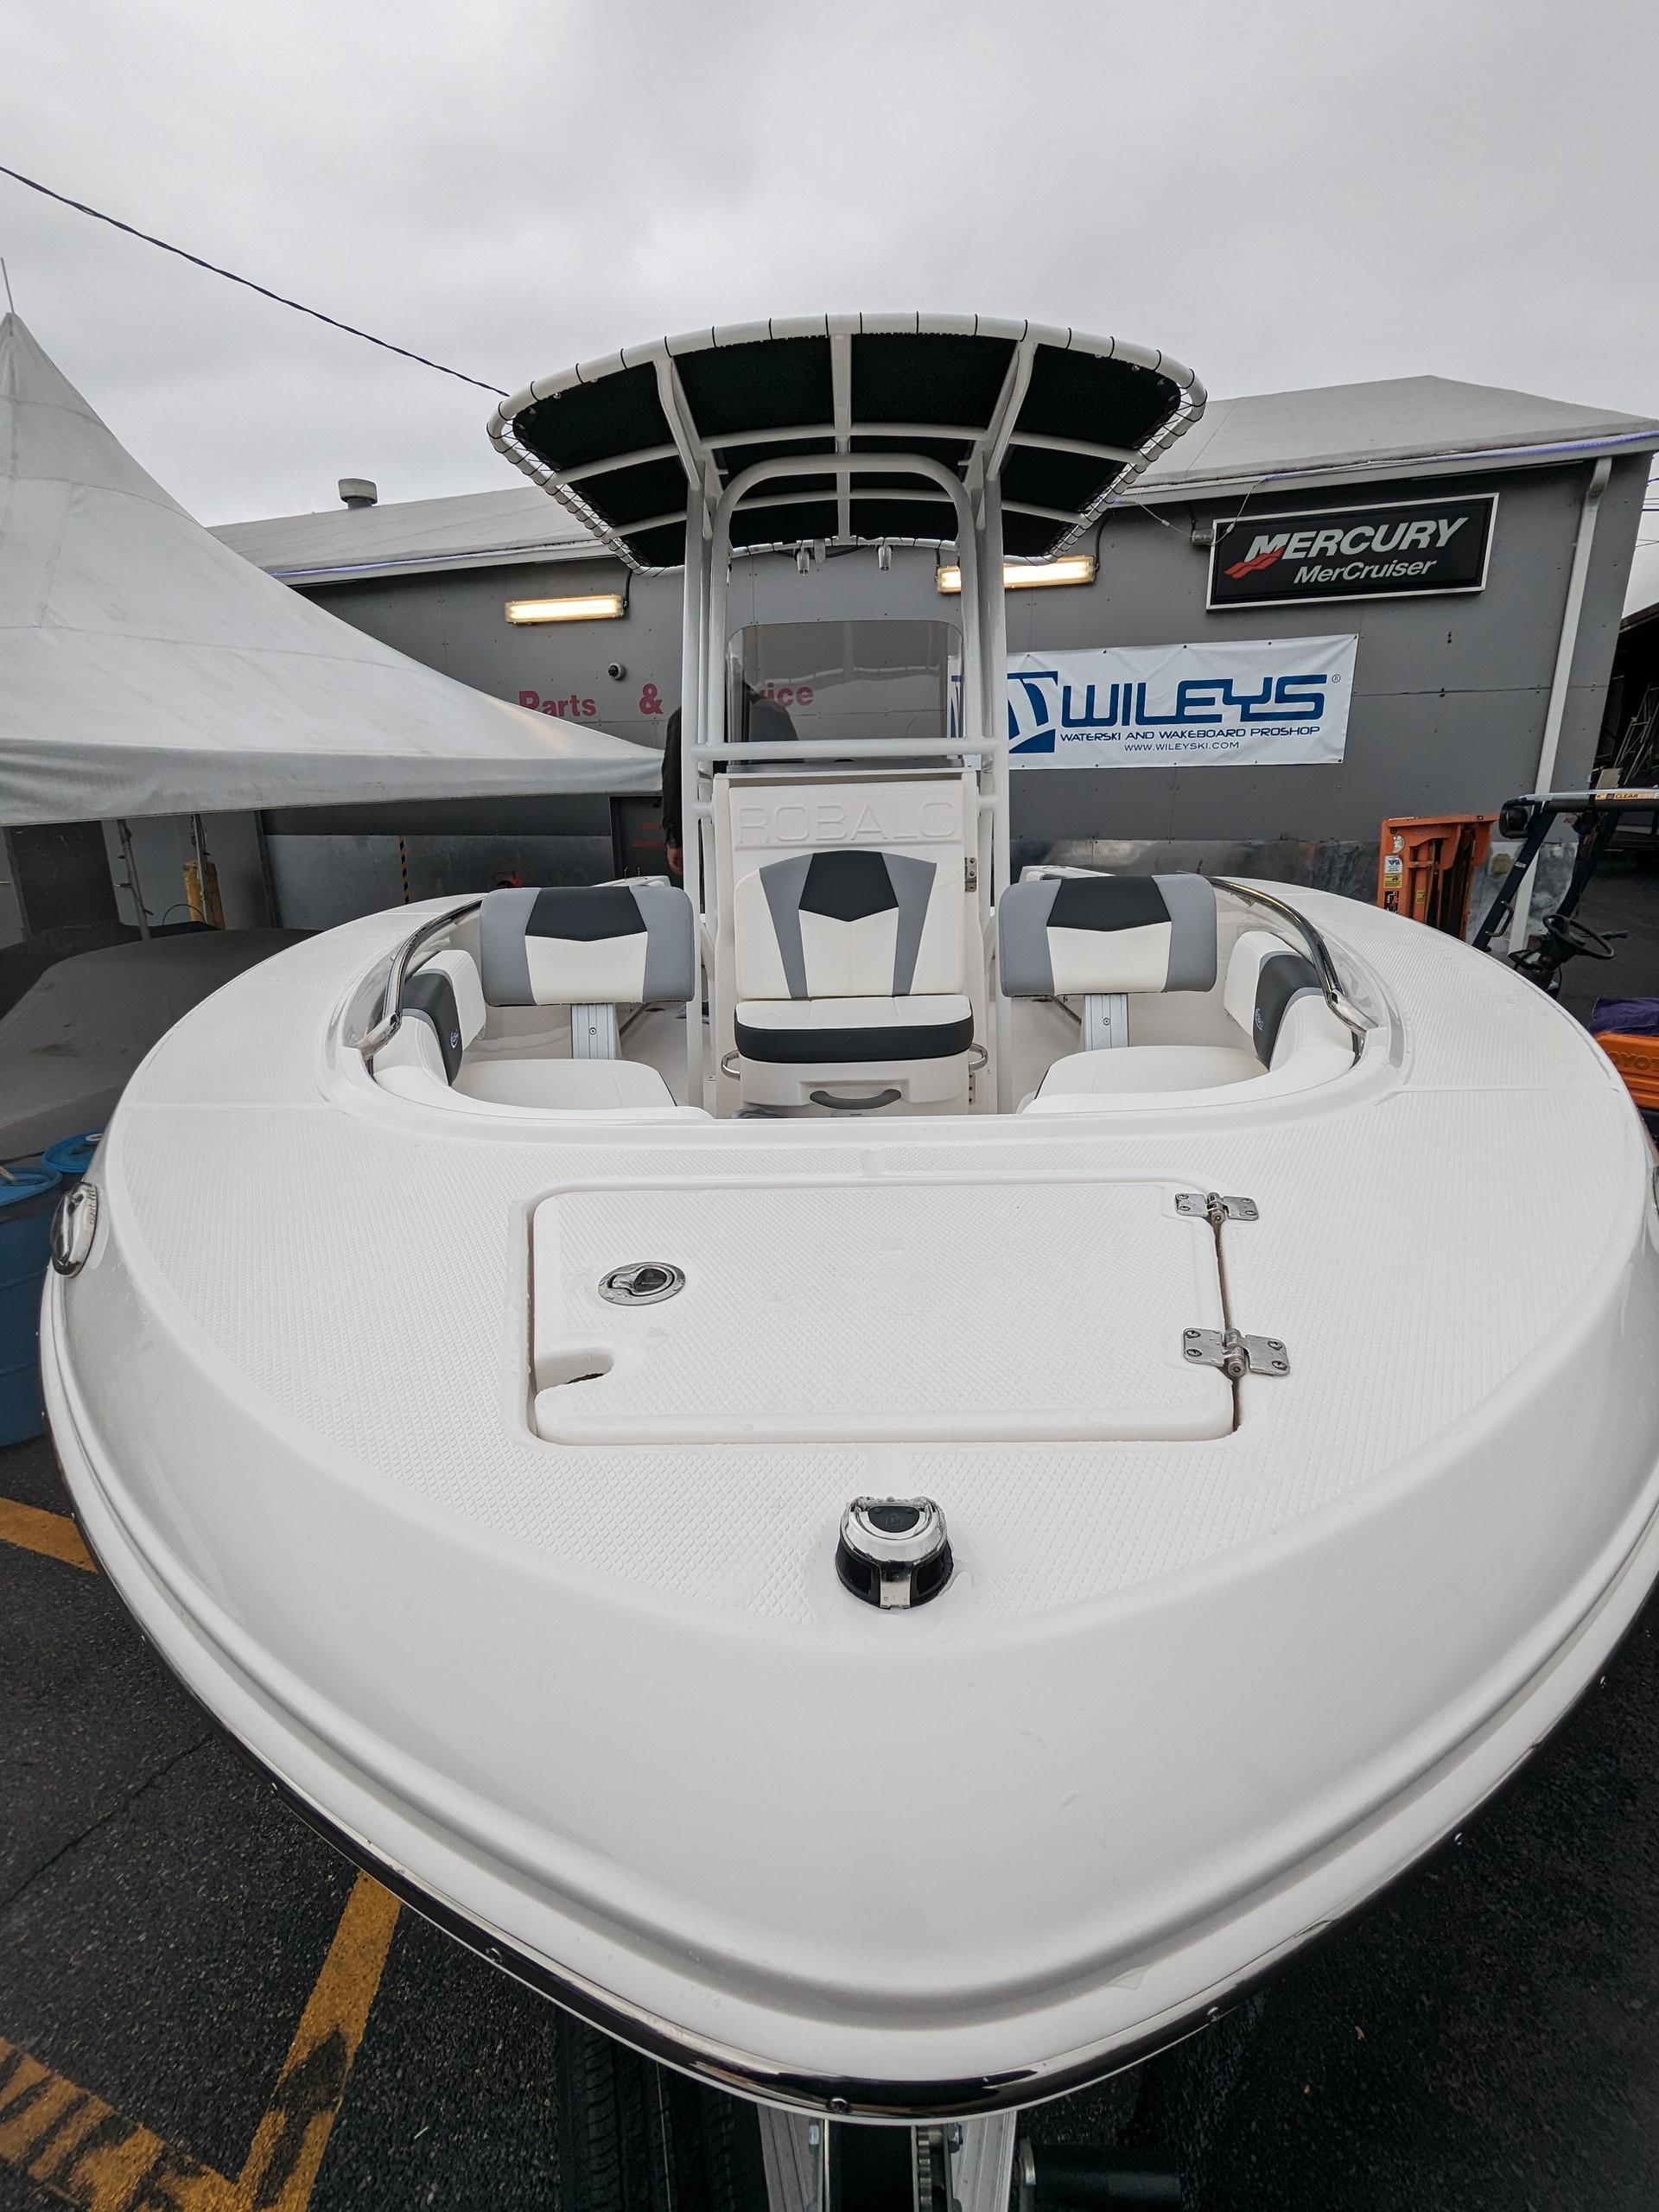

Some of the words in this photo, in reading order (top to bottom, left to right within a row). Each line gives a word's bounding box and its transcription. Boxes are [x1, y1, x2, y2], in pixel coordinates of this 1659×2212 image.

[1244, 518, 1468, 563] MERCURY
[1294, 559, 1438, 584] MerCruiser
[518, 690, 596, 717] Parts
[639, 683, 664, 715] &
[1061, 674, 1327, 728] WILEYS
[1060, 732, 1122, 742] WATERSKI
[1126, 731, 1154, 740] AND
[1159, 728, 1246, 740] WAKEBOARD
[1250, 726, 1320, 737] PROSHOP
[1124, 741, 1239, 752] WWW.WILEYSKI.COM
